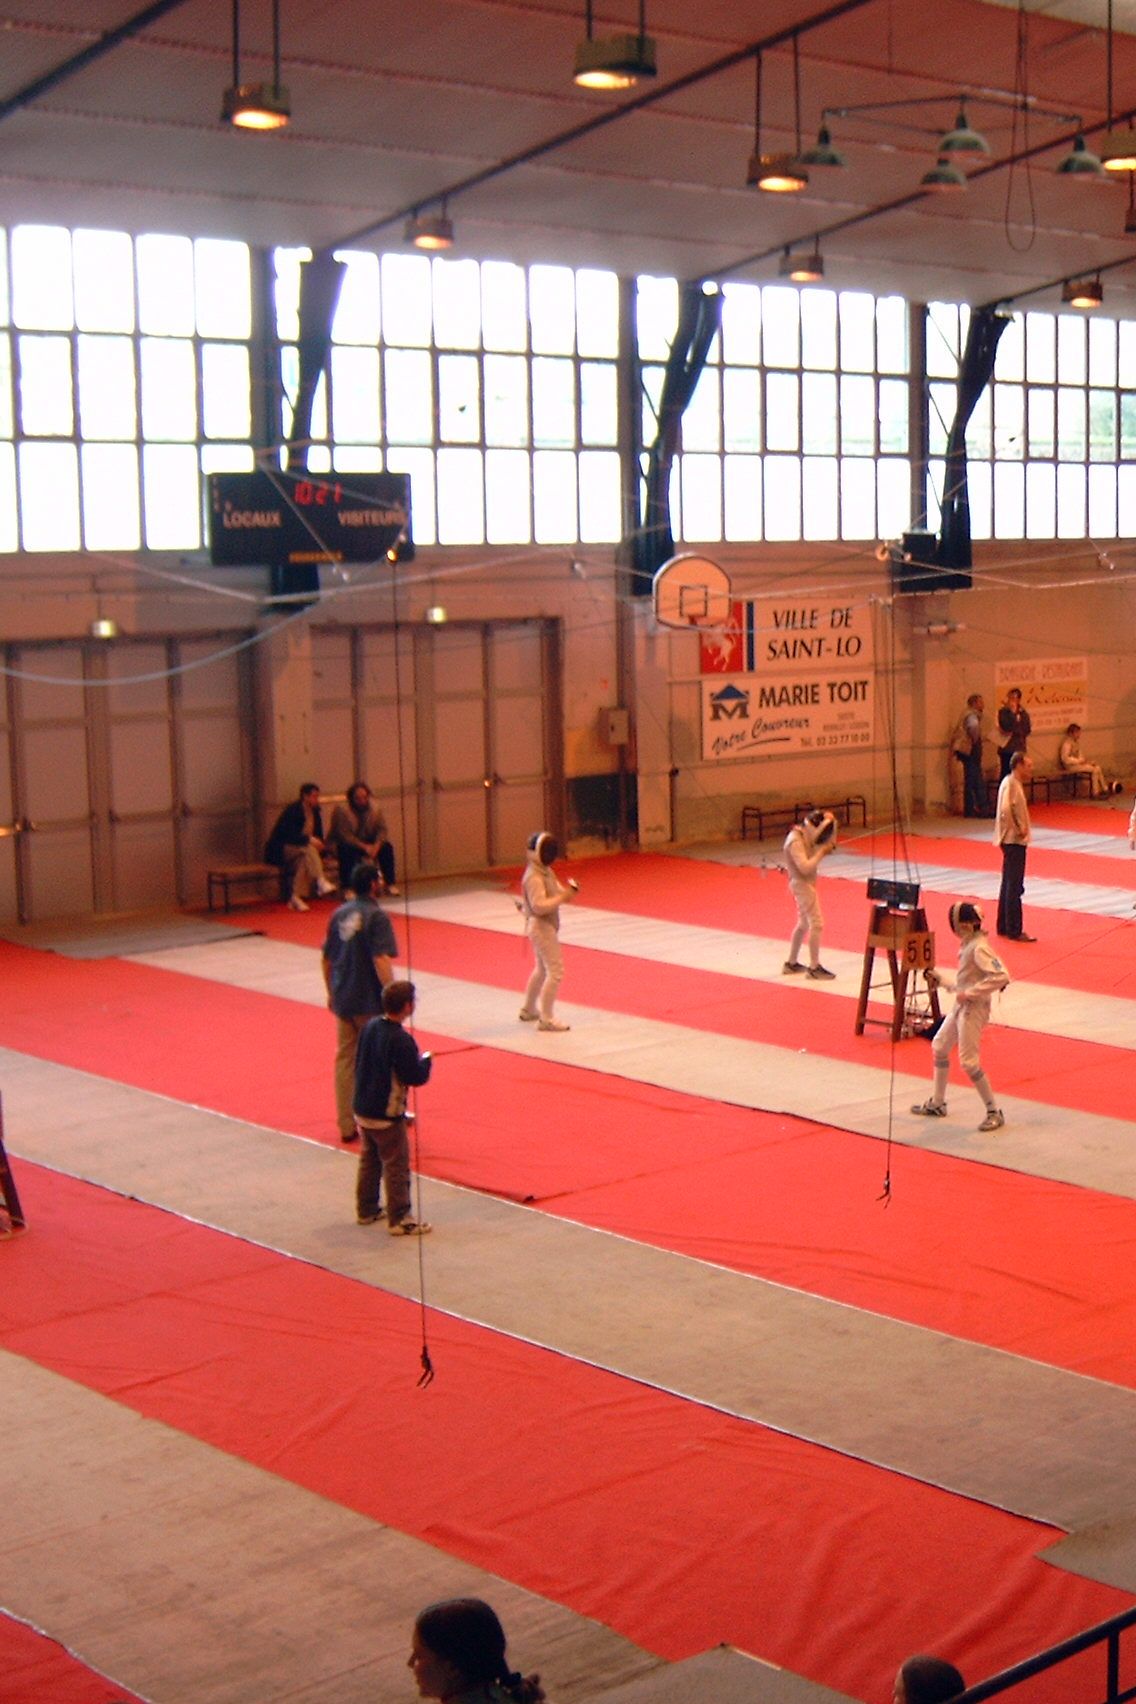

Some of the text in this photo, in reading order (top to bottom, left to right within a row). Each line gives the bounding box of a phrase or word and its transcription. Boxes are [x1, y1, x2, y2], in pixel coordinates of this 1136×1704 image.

[223, 510, 282, 528] LOCAUX
[772, 607, 853, 629] VILLE DE
[767, 636, 862, 661] SAINT-LO
[758, 681, 869, 709] MARIE TOIT
[712, 730, 746, 756] Votre
[751, 718, 810, 739] Couvreur
